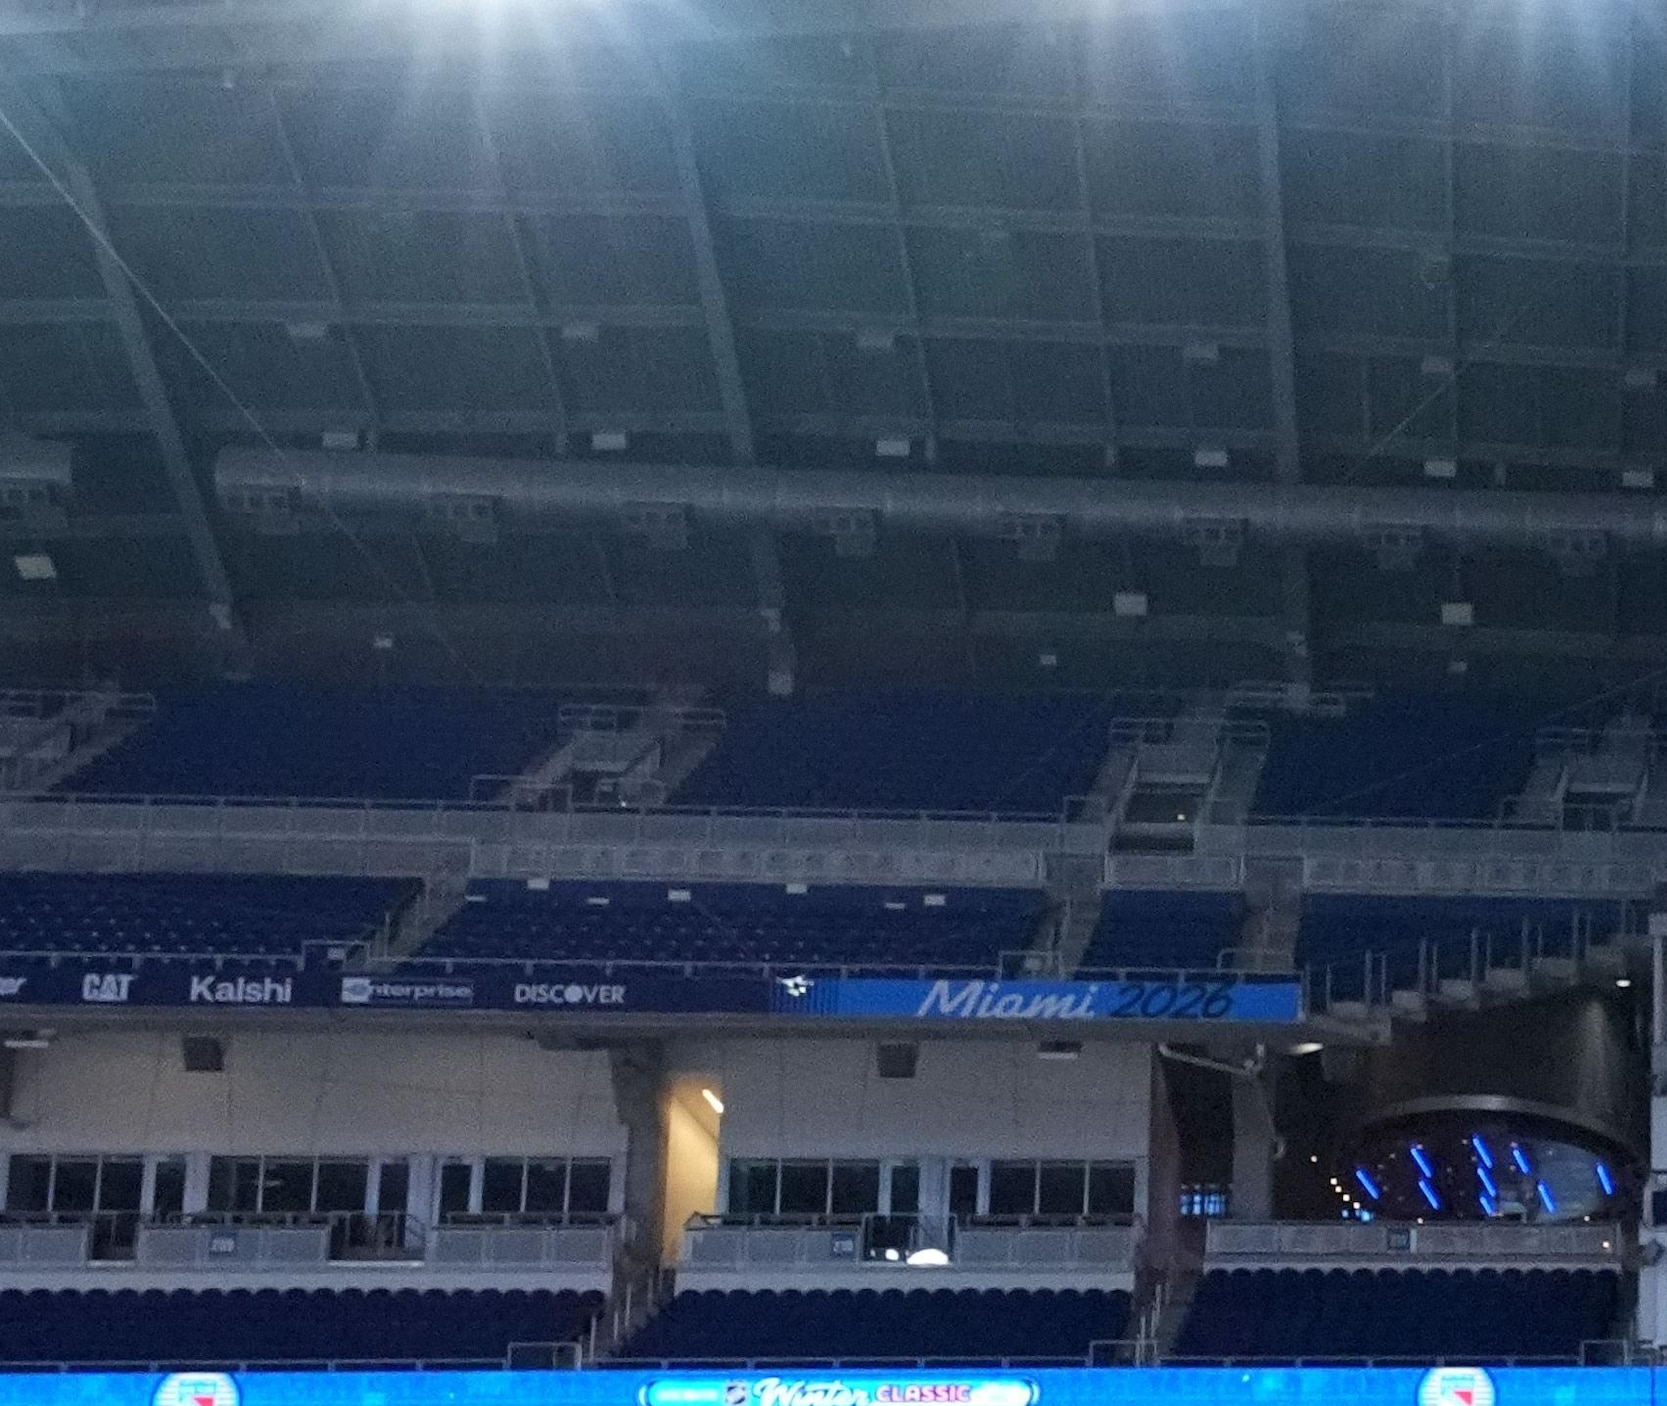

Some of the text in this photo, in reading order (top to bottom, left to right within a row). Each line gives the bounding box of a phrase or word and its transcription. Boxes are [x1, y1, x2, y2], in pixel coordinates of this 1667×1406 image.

[82, 973, 138, 1001] CAT
[190, 974, 293, 1003] Kalshi
[514, 983, 626, 1004] DISCOVER
[917, 977, 1239, 1019] Miami 2026
[875, 1383, 972, 1404] CLASSIC
